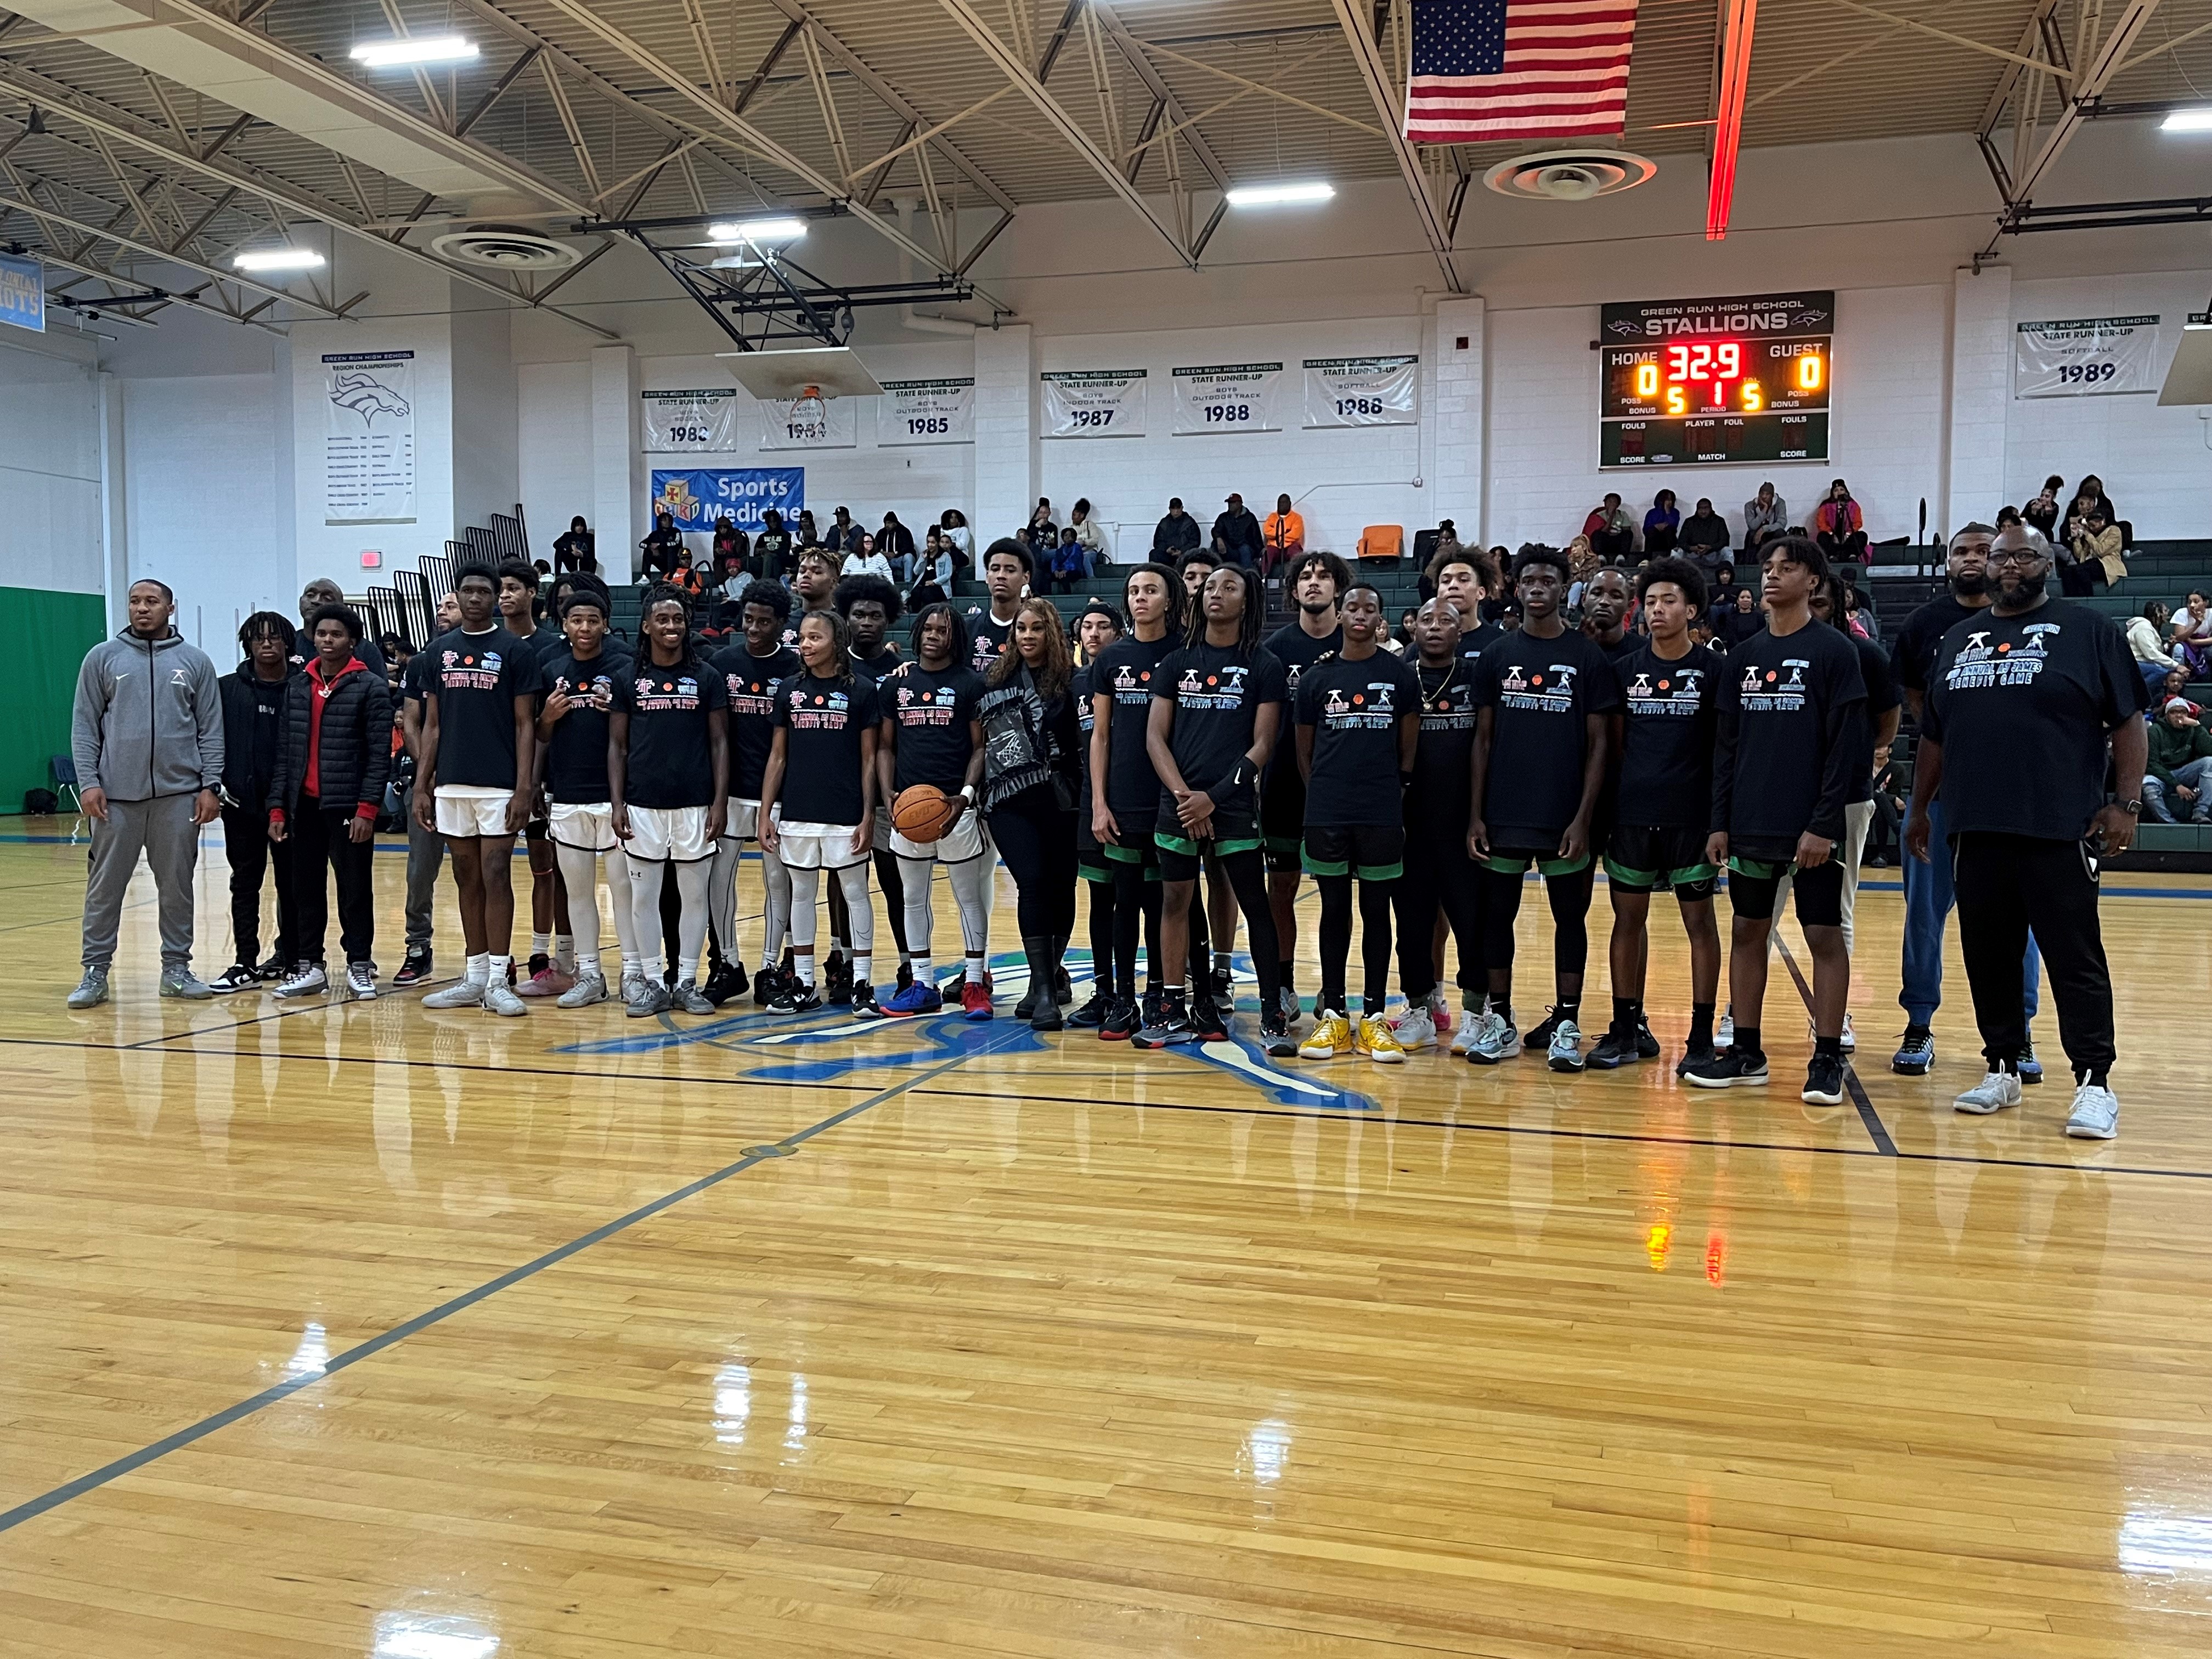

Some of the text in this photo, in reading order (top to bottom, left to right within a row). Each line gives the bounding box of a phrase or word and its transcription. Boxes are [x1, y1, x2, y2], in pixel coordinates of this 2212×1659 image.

[1641, 300, 1804, 316] GREEN RUN HIGH SCHOOL
[1645, 312, 1788, 336] STALLIONS
[2113, 317, 2155, 326] SCHOOL
[2042, 328, 2134, 340] STATE RUNNER-UP
[1612, 351, 1658, 365] HOME
[1769, 343, 1822, 358] GUEST
[1348, 366, 1397, 375] RUNNER-UP
[1668, 343, 1740, 381] 32.9
[1216, 374, 1263, 382] RUNNER-UP
[1637, 364, 1658, 396] 0
[1799, 356, 1821, 389] 0
[2058, 363, 2116, 383] 1989
[1667, 387, 1685, 414] 5
[1714, 381, 1723, 404] 1
[1743, 382, 1760, 411] 5
[1204, 405, 1249, 422] 1988
[1336, 397, 1383, 415] 1988
[907, 417, 949, 435] 1985
[1071, 410, 1115, 427] 1987
[718, 477, 788, 501] Sports
[1960, 663, 1995, 676] ANNUAL
[1996, 662, 2011, 674] AJ
[2011, 662, 2043, 673] JAMES
[1949, 673, 2033, 690] BENEFIT GAME
